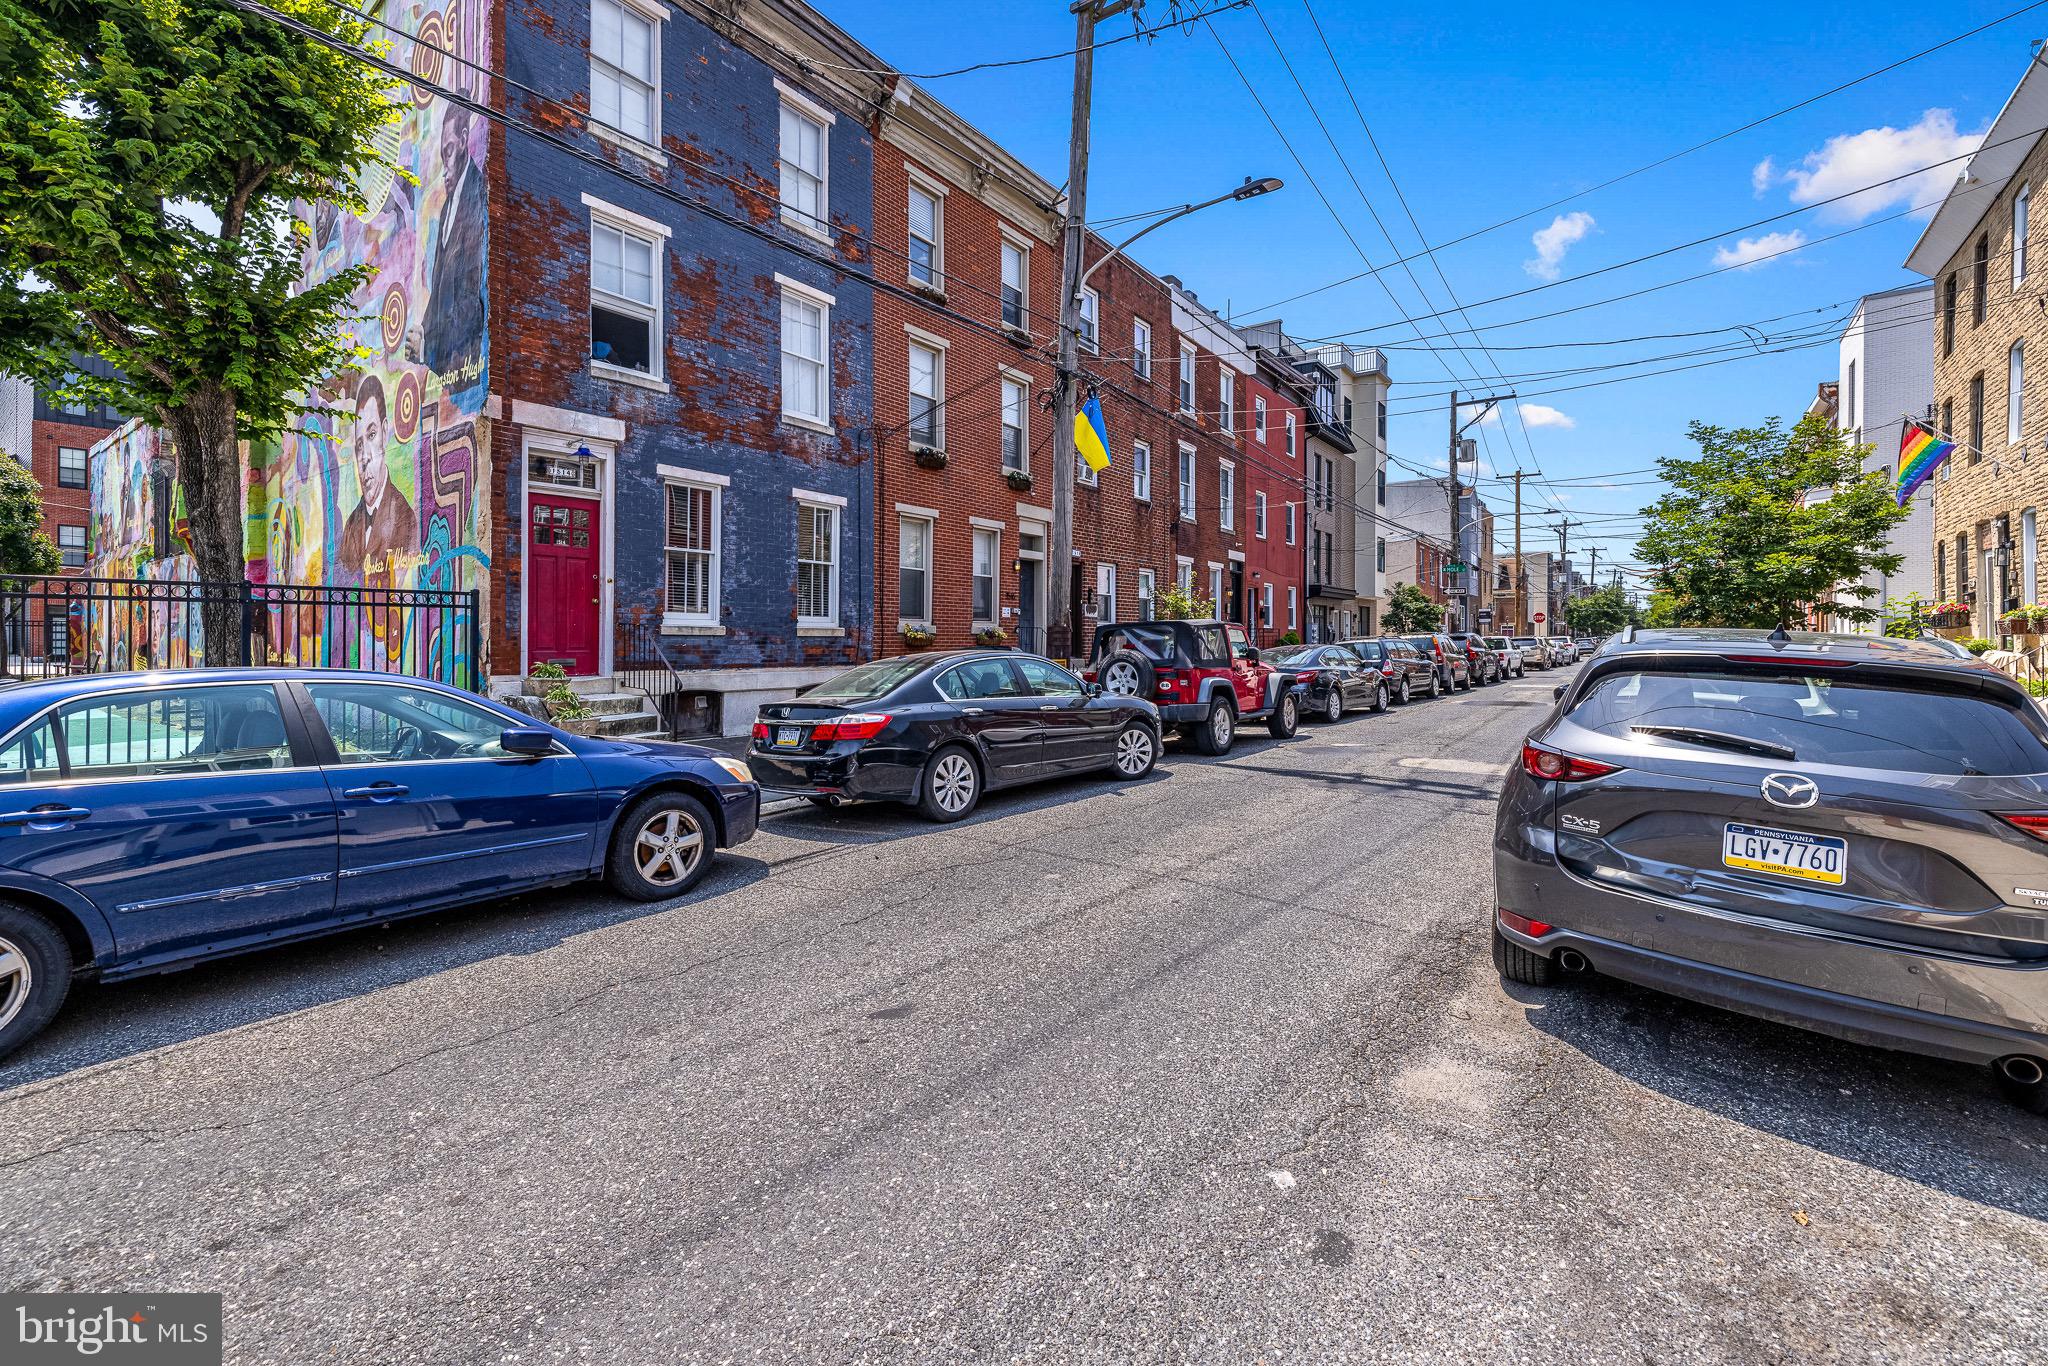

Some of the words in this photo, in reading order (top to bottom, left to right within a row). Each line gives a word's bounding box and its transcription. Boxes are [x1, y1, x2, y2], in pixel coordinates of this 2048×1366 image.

[1561, 814, 1601, 829] CX-5
[1754, 829, 1815, 843] PENNSYLVANIA
[1760, 863, 1804, 875] visitPA.com
